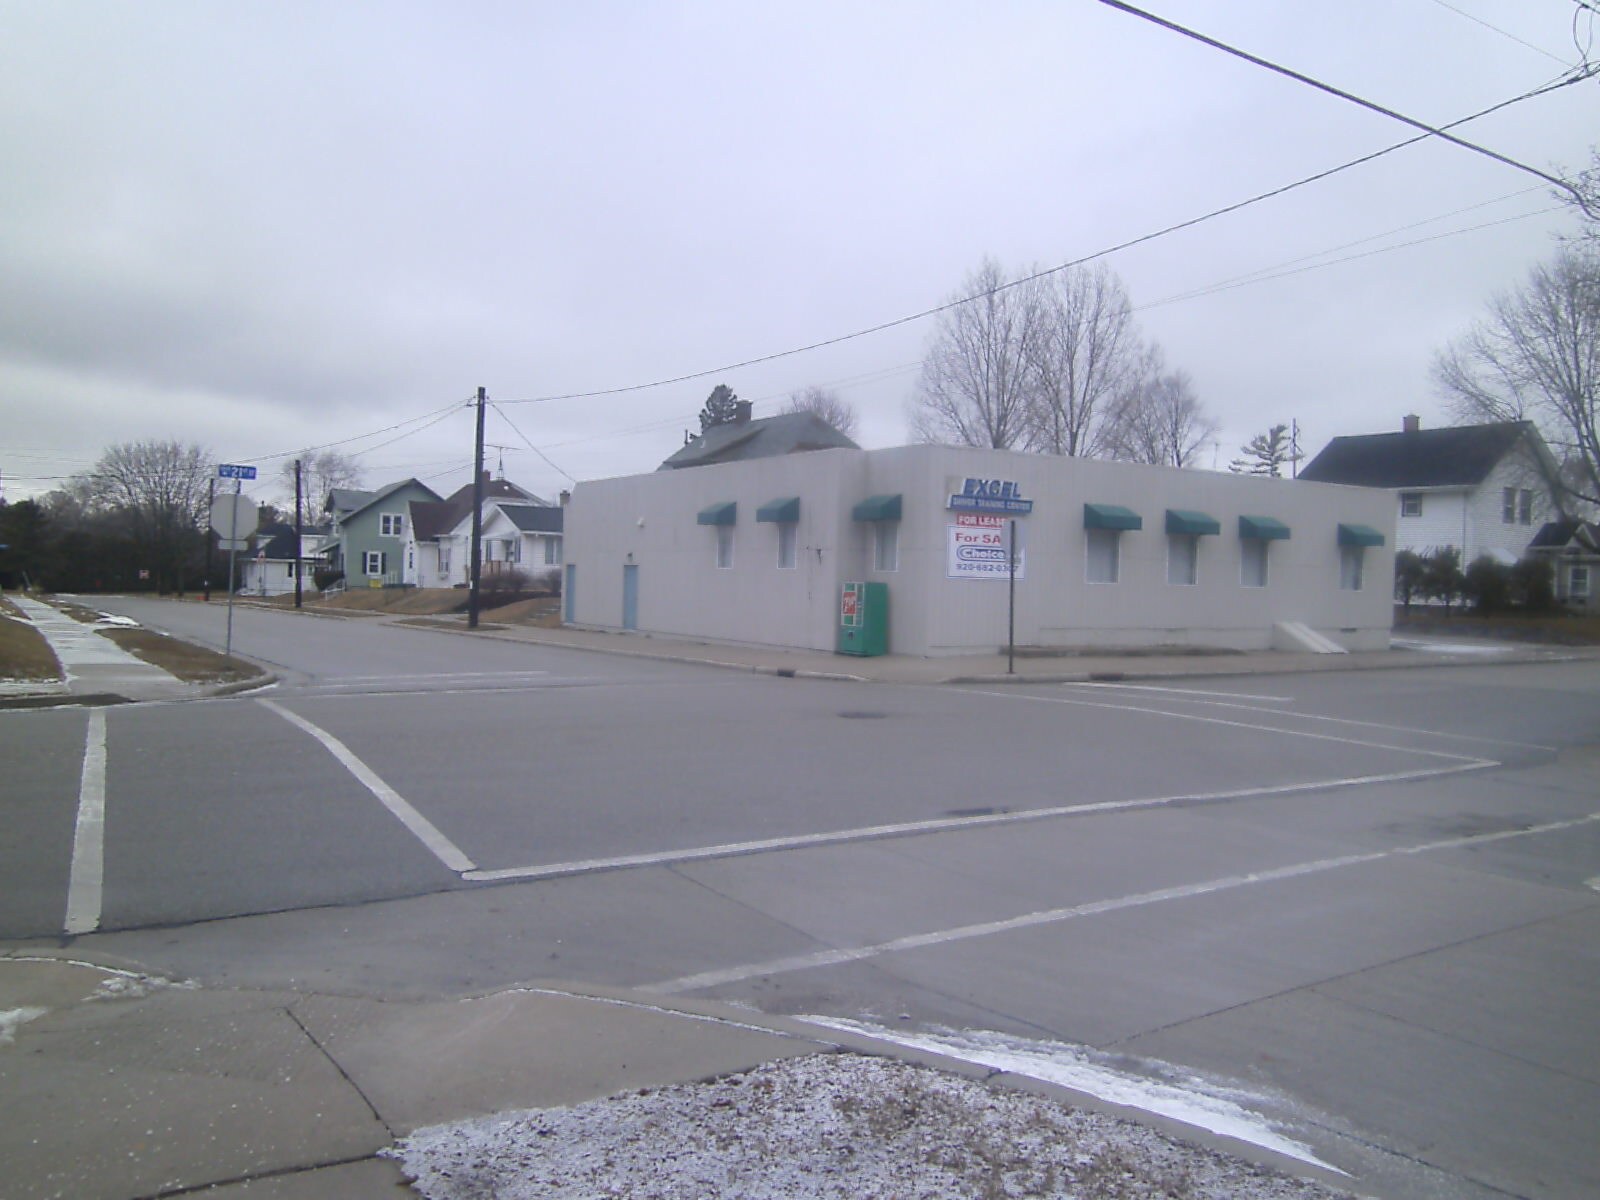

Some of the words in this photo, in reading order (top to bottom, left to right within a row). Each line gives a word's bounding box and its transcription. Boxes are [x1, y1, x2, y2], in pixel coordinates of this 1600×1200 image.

[963, 478, 1021, 498] EXCEL
[959, 515, 977, 525] FOR
[955, 533, 979, 542] For
[961, 548, 1005, 559] Choice
